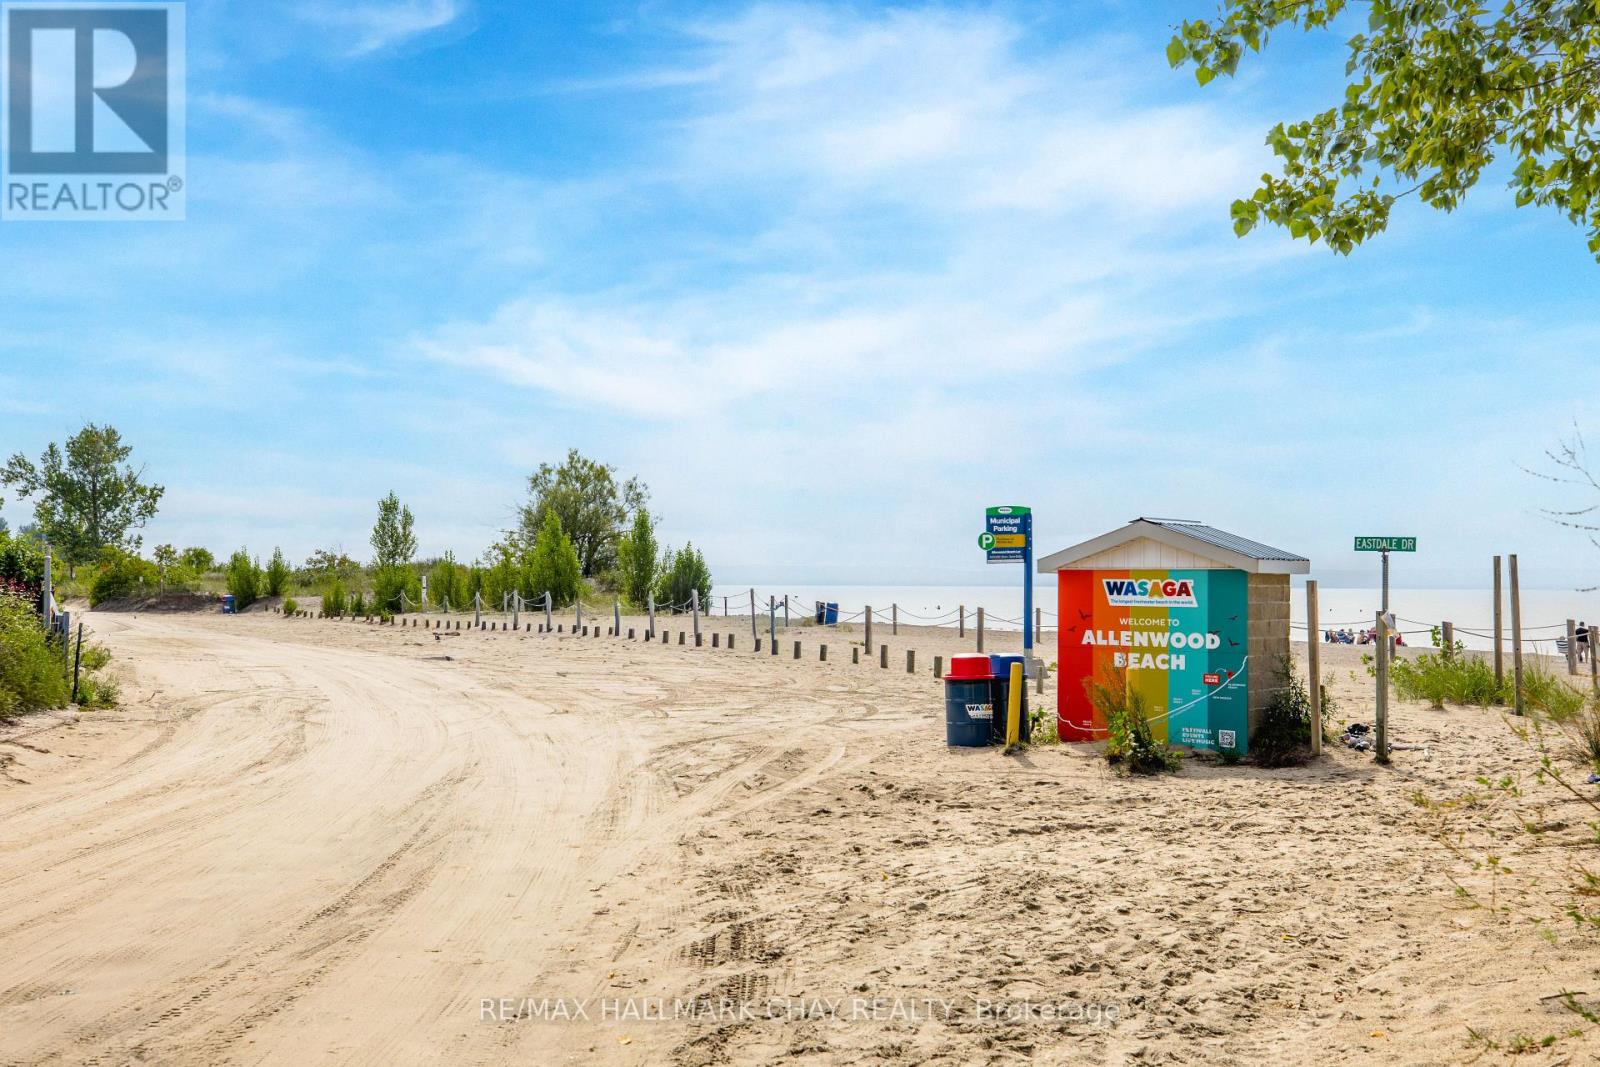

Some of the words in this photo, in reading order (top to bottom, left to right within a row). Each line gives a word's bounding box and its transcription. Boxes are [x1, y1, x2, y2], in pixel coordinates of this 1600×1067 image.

[990, 517, 1020, 525] Municipal
[993, 525, 1018, 533] Parking
[982, 534, 993, 548] P
[1356, 538, 1397, 550] EASTDALE
[1401, 538, 1414, 550] DR
[1105, 581, 1192, 598] WASAGA
[1119, 617, 1166, 627] WELCOME
[1168, 618, 1180, 627] TO
[1082, 629, 1220, 649] ALLENWOOD
[1114, 652, 1186, 670] BEACH
